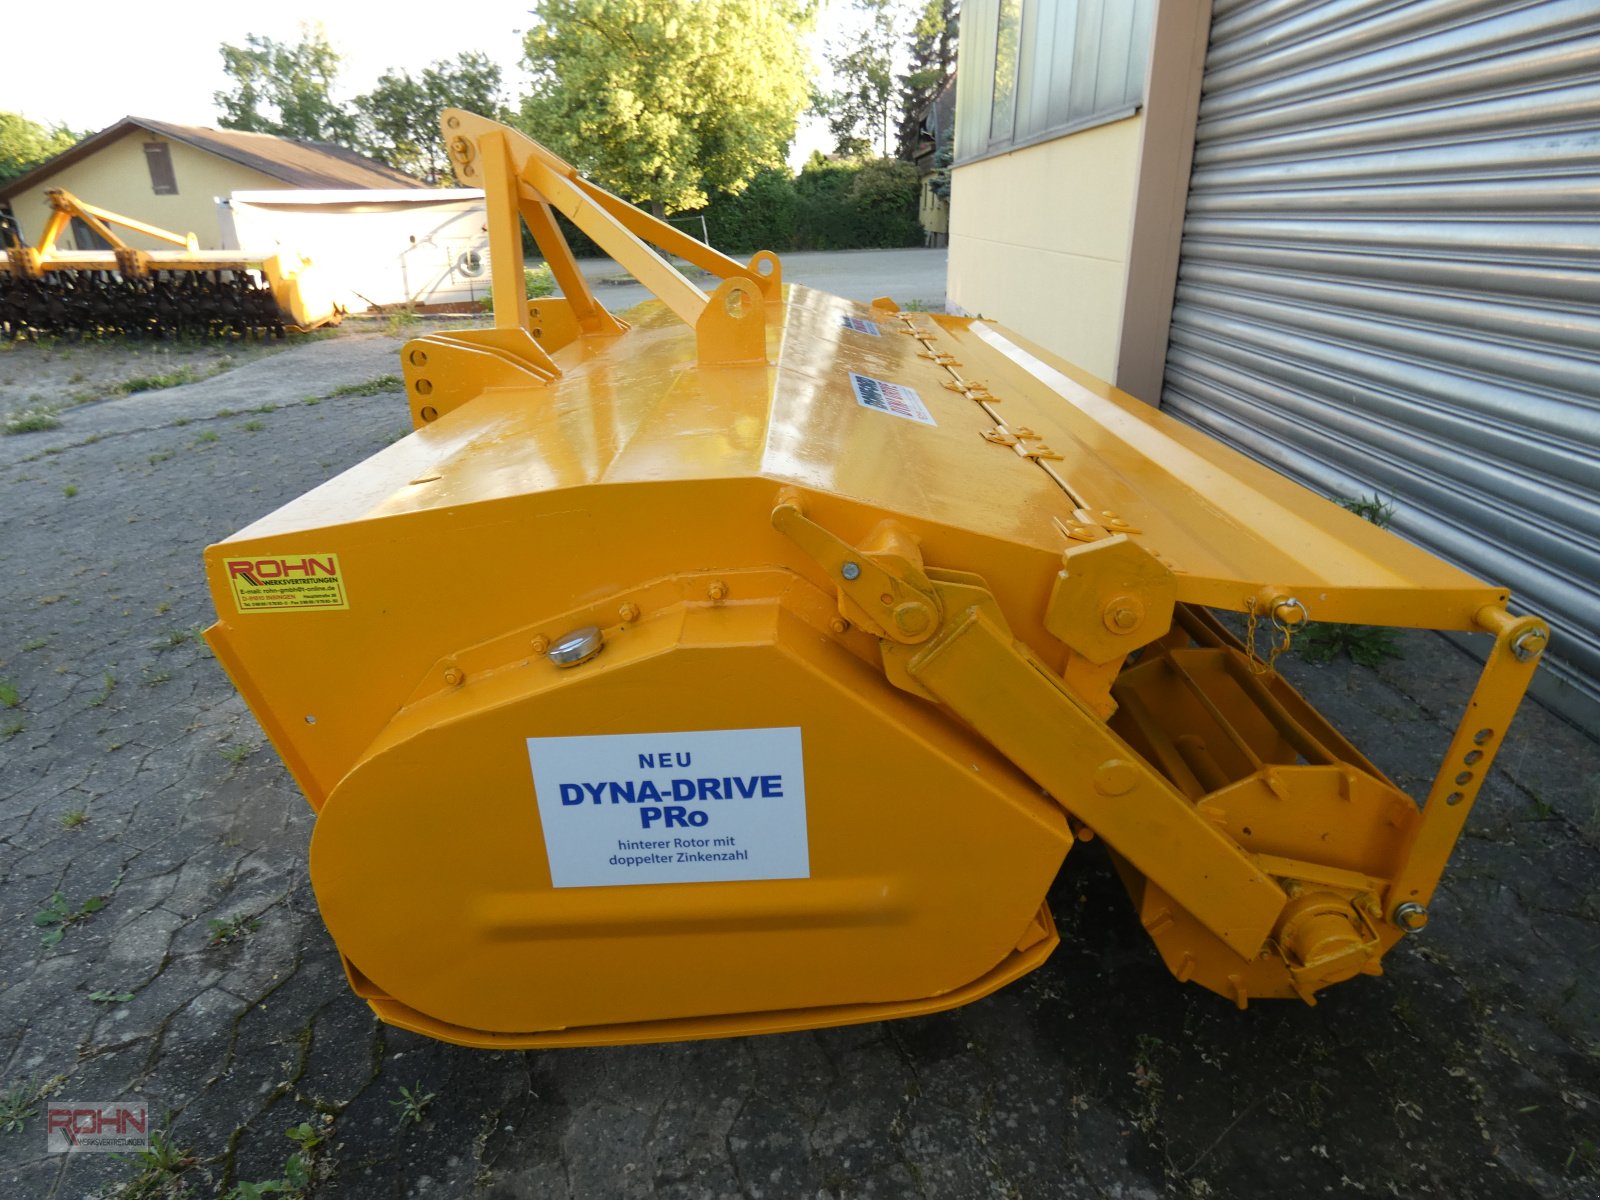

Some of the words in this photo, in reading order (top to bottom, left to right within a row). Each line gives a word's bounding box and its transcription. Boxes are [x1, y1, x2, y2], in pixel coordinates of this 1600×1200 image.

[227, 557, 337, 586] ROHN
[262, 577, 338, 586] WERKSVERTRETUNGEN
[638, 751, 692, 769] NEU
[558, 774, 784, 806] DYNA-DRIVE
[639, 805, 709, 829] PRo
[617, 838, 671, 851] hinterer
[673, 837, 711, 849] Rotor
[713, 836, 736, 848] mit
[608, 853, 673, 867] doppelter
[675, 849, 749, 864] Zinkenzahl
